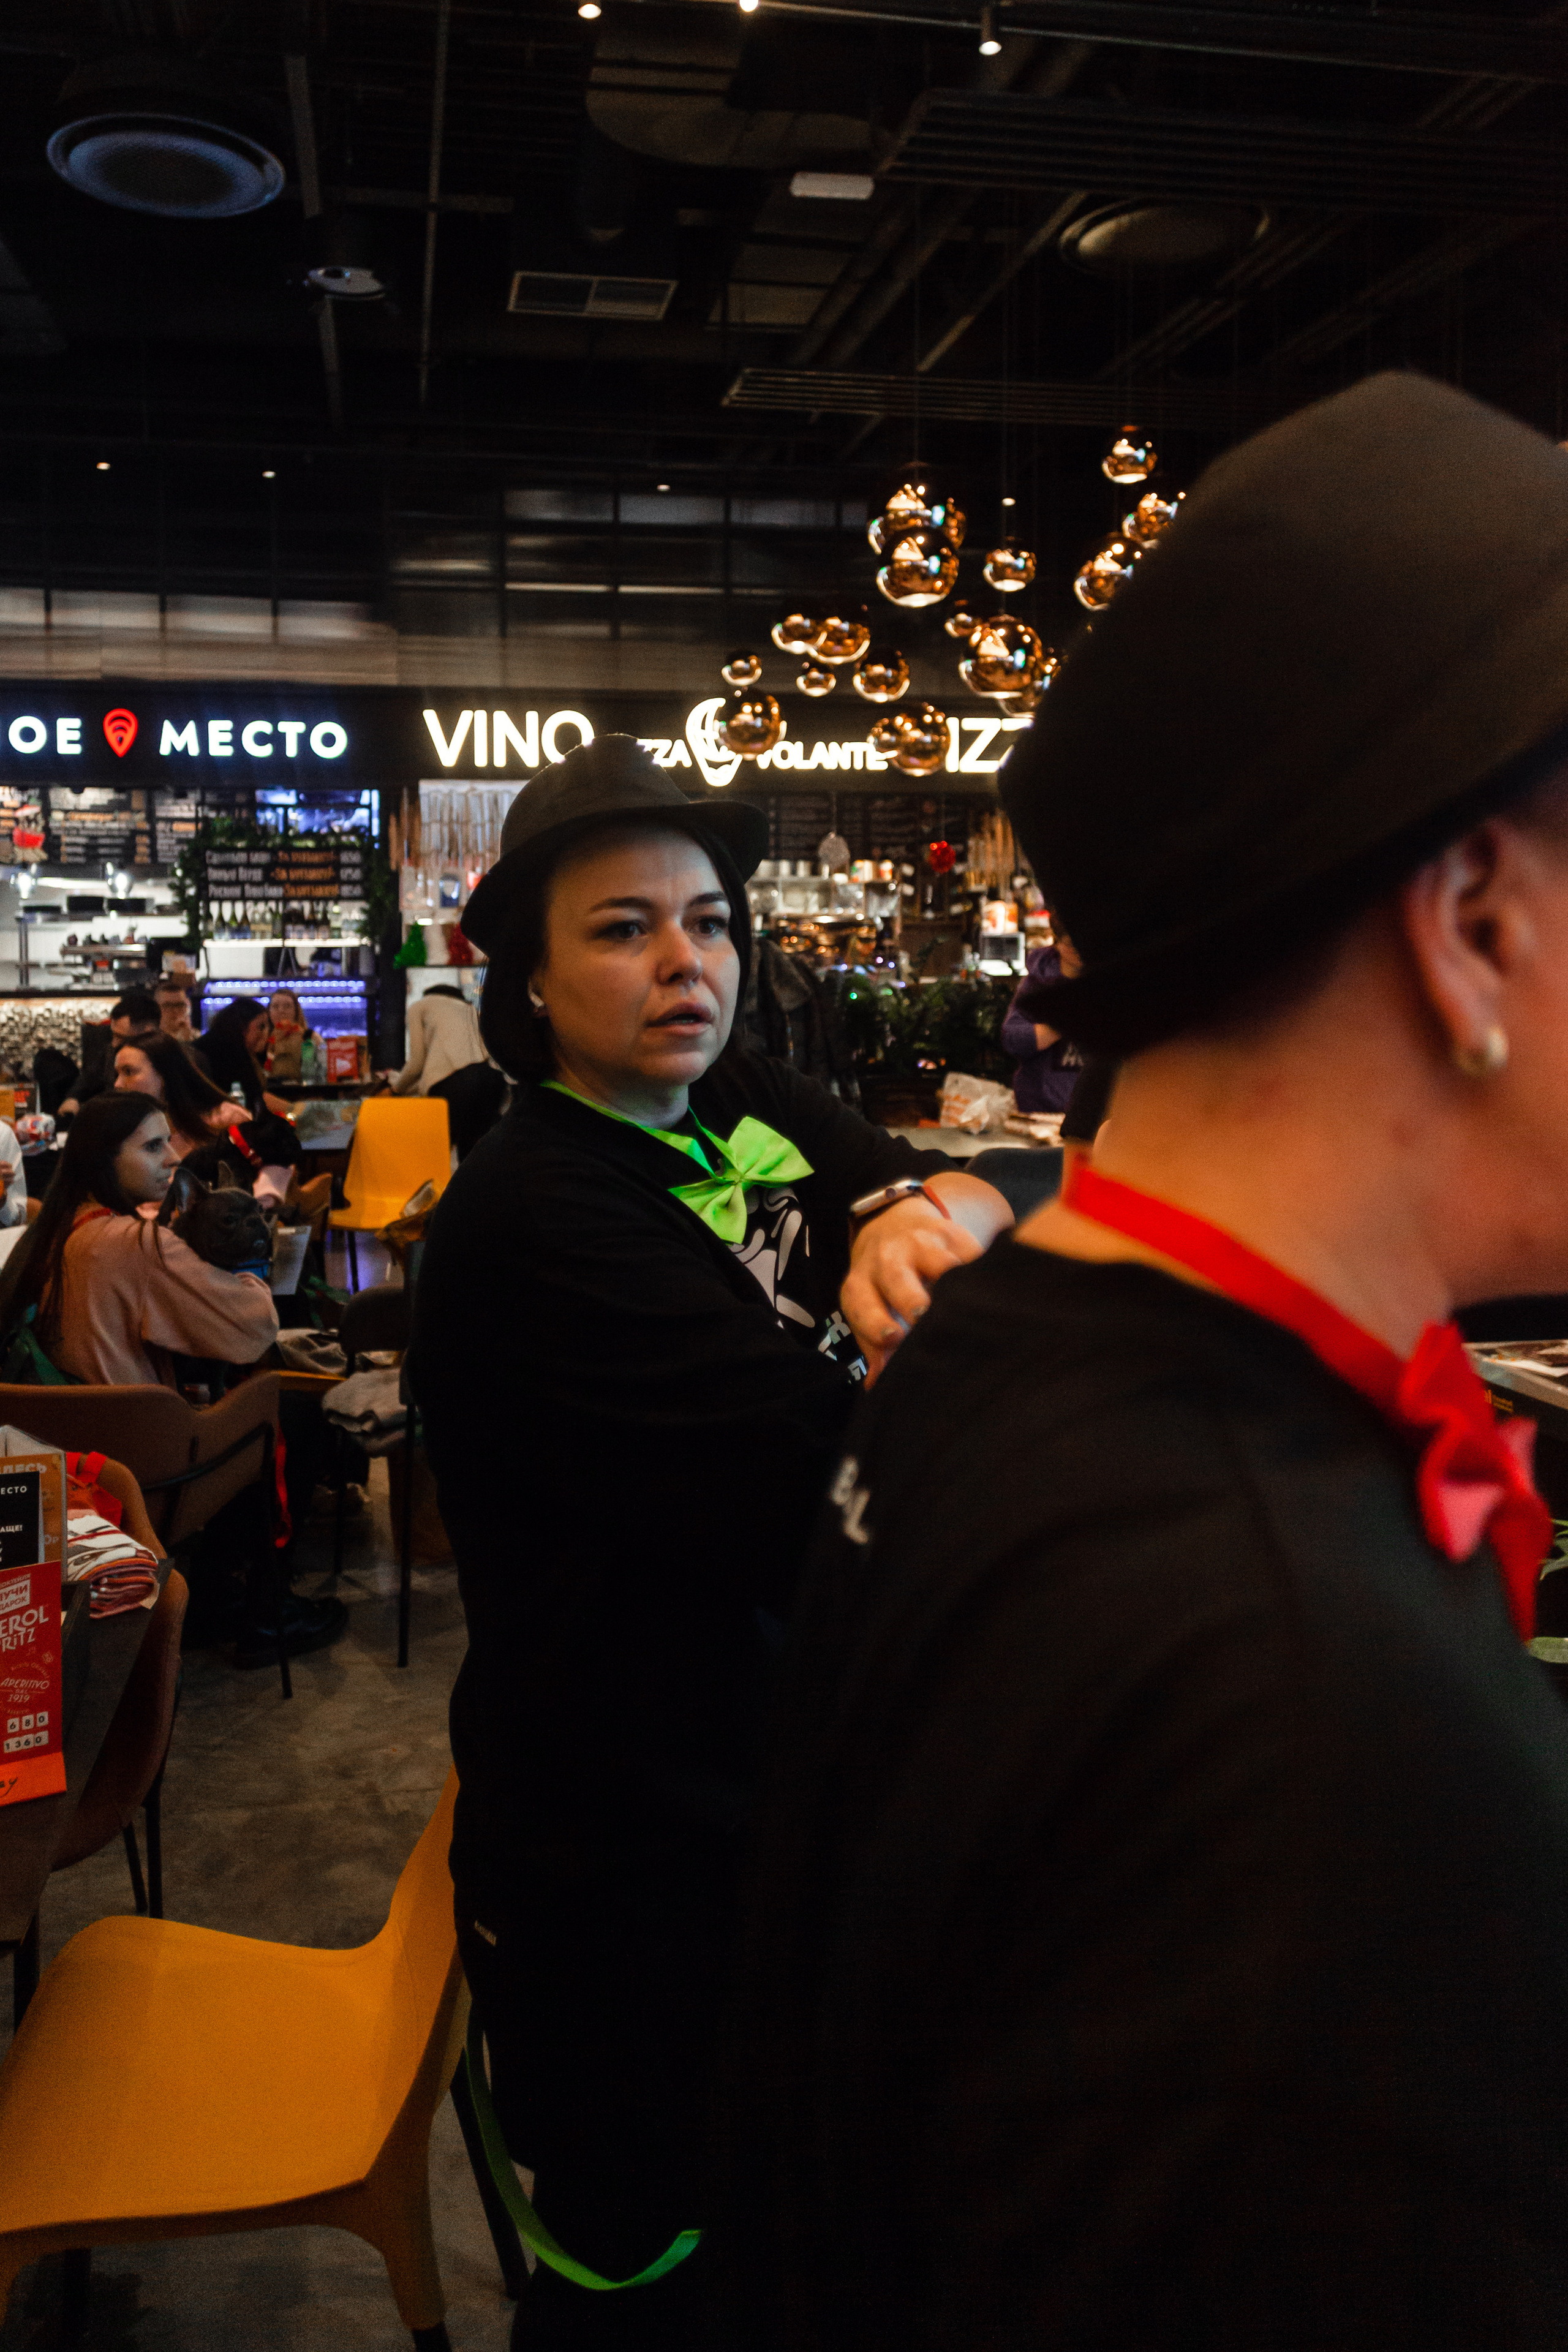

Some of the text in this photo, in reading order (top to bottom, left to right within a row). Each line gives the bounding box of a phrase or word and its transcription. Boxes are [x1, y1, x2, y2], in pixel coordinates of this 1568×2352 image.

[159, 719, 348, 759] МЕСТО
[423, 709, 595, 767] VINO
[0, 1678, 50, 1689] APERITIVO
[7, 1694, 30, 1703] 1919
